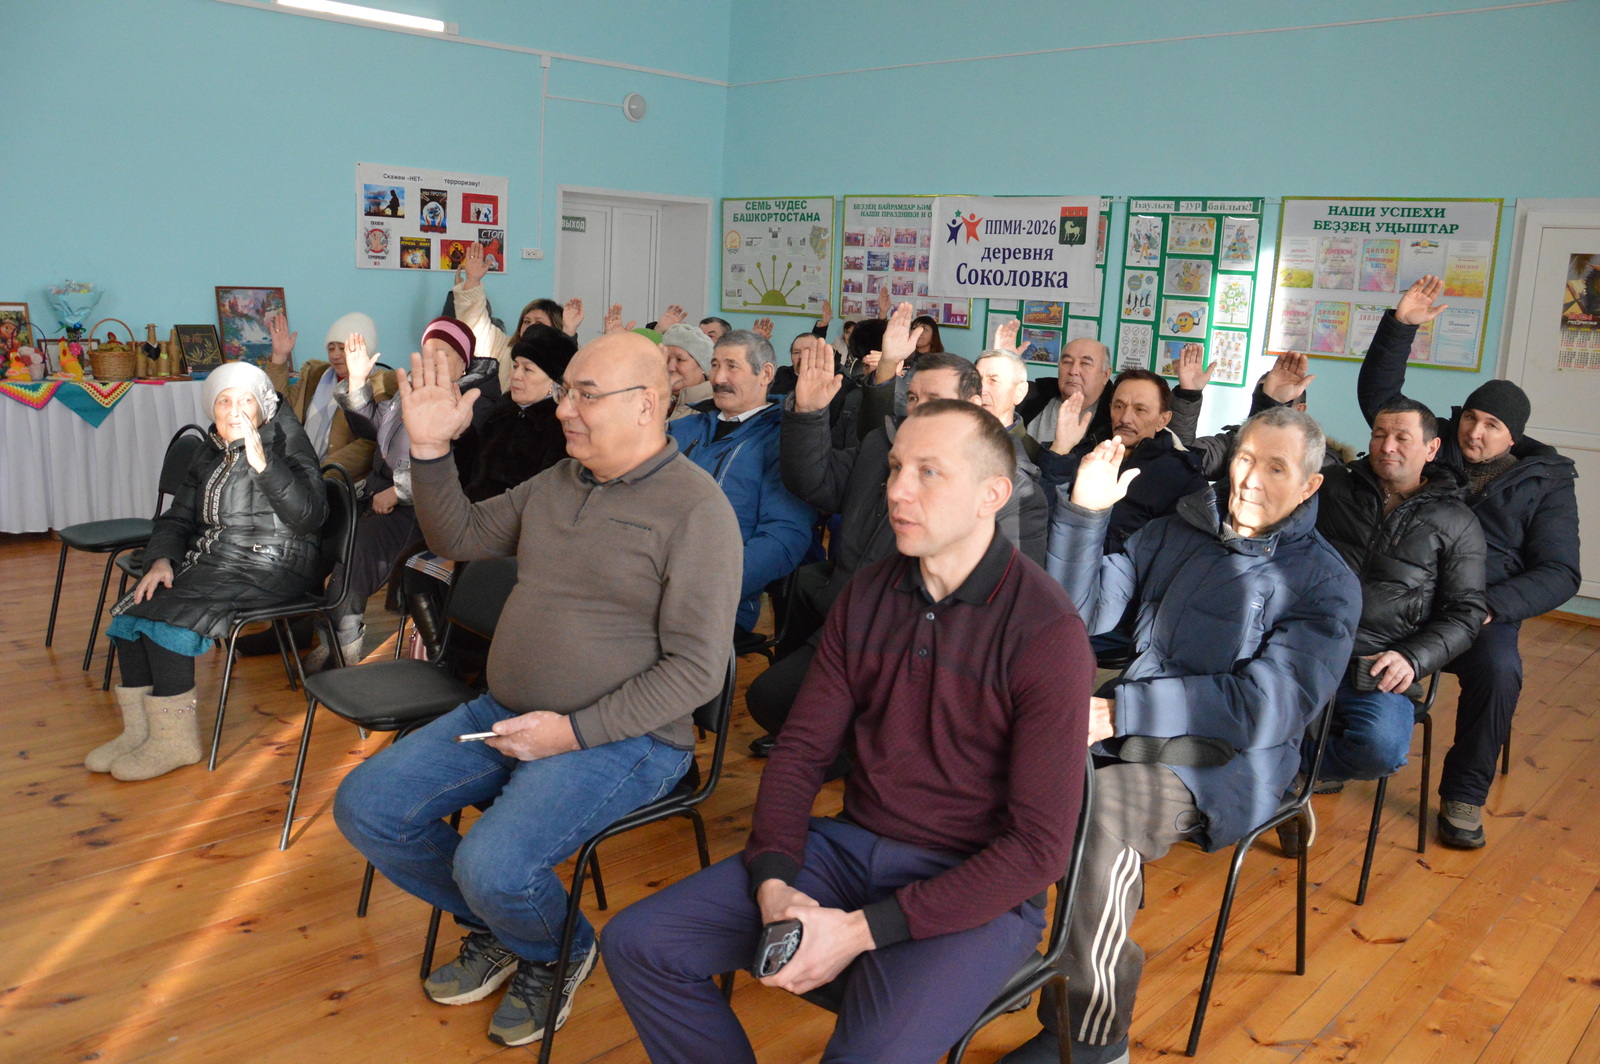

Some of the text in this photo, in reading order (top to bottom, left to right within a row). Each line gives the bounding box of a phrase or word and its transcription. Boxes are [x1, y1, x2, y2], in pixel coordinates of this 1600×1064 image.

[444, 178, 481, 188] терроризму!
[745, 200, 808, 211] СЕМЬ ЧУДЕС
[877, 202, 916, 210] БАЙРАМДАР
[733, 212, 821, 222] БАШКОРТОСТАНА
[1327, 205, 1446, 218] НАШИ УСПЕХИ
[561, 219, 585, 231] ВЫХОД
[984, 219, 1057, 236] ППМИ-2026
[481, 229, 504, 239] СТОП
[980, 246, 1054, 264] деревня
[956, 262, 1069, 289] Соколовка
